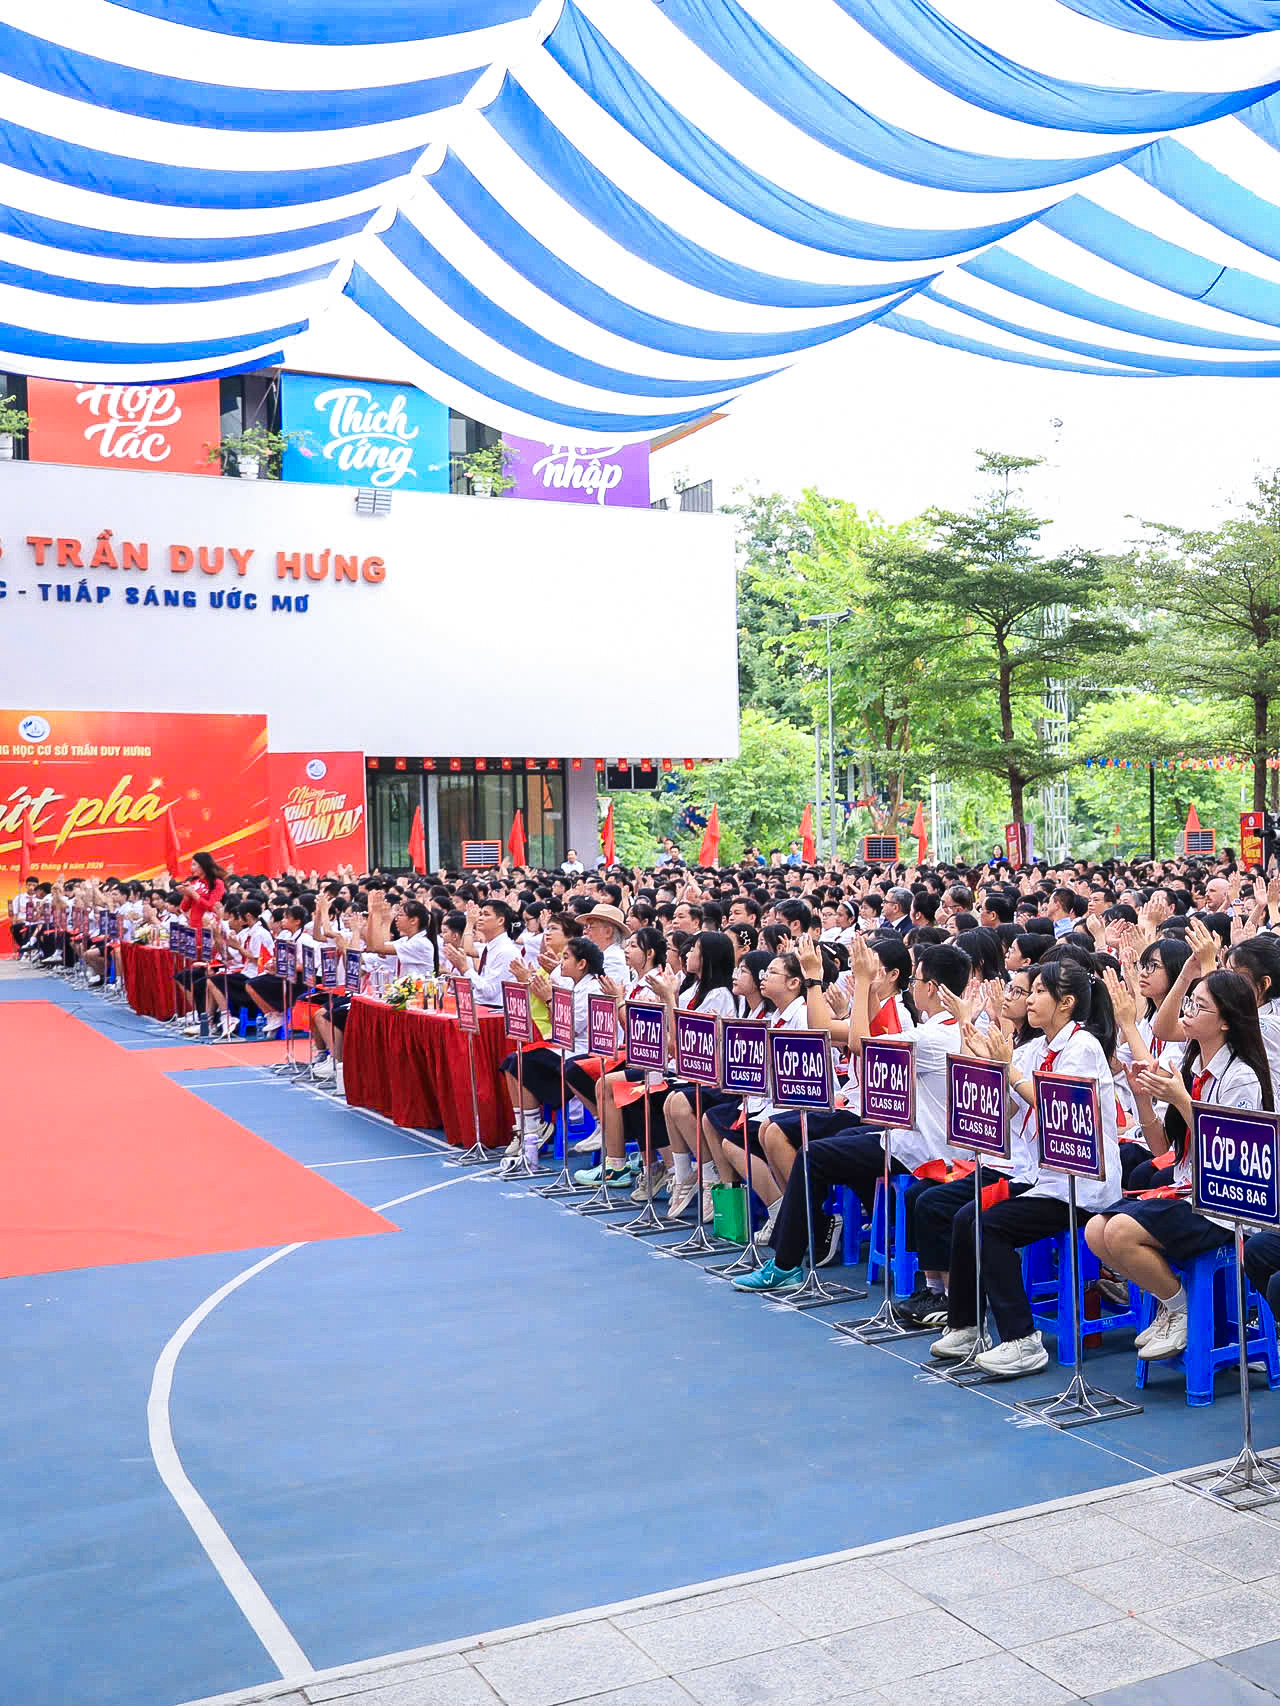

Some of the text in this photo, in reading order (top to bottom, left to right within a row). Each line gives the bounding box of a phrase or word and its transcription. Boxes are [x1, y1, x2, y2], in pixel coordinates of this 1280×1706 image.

[314, 387, 419, 440] Thích
[26, 528, 388, 584] TRẦN DUY HƯNG
[38, 578, 111, 604] THẮP
[125, 584, 198, 609] SÁNG
[209, 586, 258, 611] ƯỚC
[271, 594, 311, 613] MƠ
[12, 744, 35, 758] HỌC
[37, 744, 52, 756] CƠ
[100, 745, 121, 756] DUY
[123, 745, 153, 757] HƯNG
[53, 774, 177, 856] phá
[630, 1014, 661, 1044] LỚP 7A7
[679, 1024, 714, 1056] LỚP 7A8
[633, 1049, 659, 1060] CLASS 7A7
[683, 1058, 701, 1071] CLASS
[728, 1033, 764, 1065] LỚP 7A9
[776, 1044, 823, 1078] LỚP 8A0
[731, 1070, 750, 1081] CLASS
[868, 1055, 909, 1092] LỚP 8A1
[782, 1083, 822, 1097] CLASS 8A0
[870, 1096, 905, 1112] CLASS 8A1
[955, 1073, 1000, 1117] LỚP 8A2
[959, 1118, 997, 1138] CLASS 8A2
[1045, 1091, 1093, 1137] LỚP 8A3
[1050, 1139, 1092, 1159] CLASS 8A3
[1202, 1126, 1272, 1180] LỚP 8A6
[1207, 1181, 1267, 1207] CLASS 8A6
